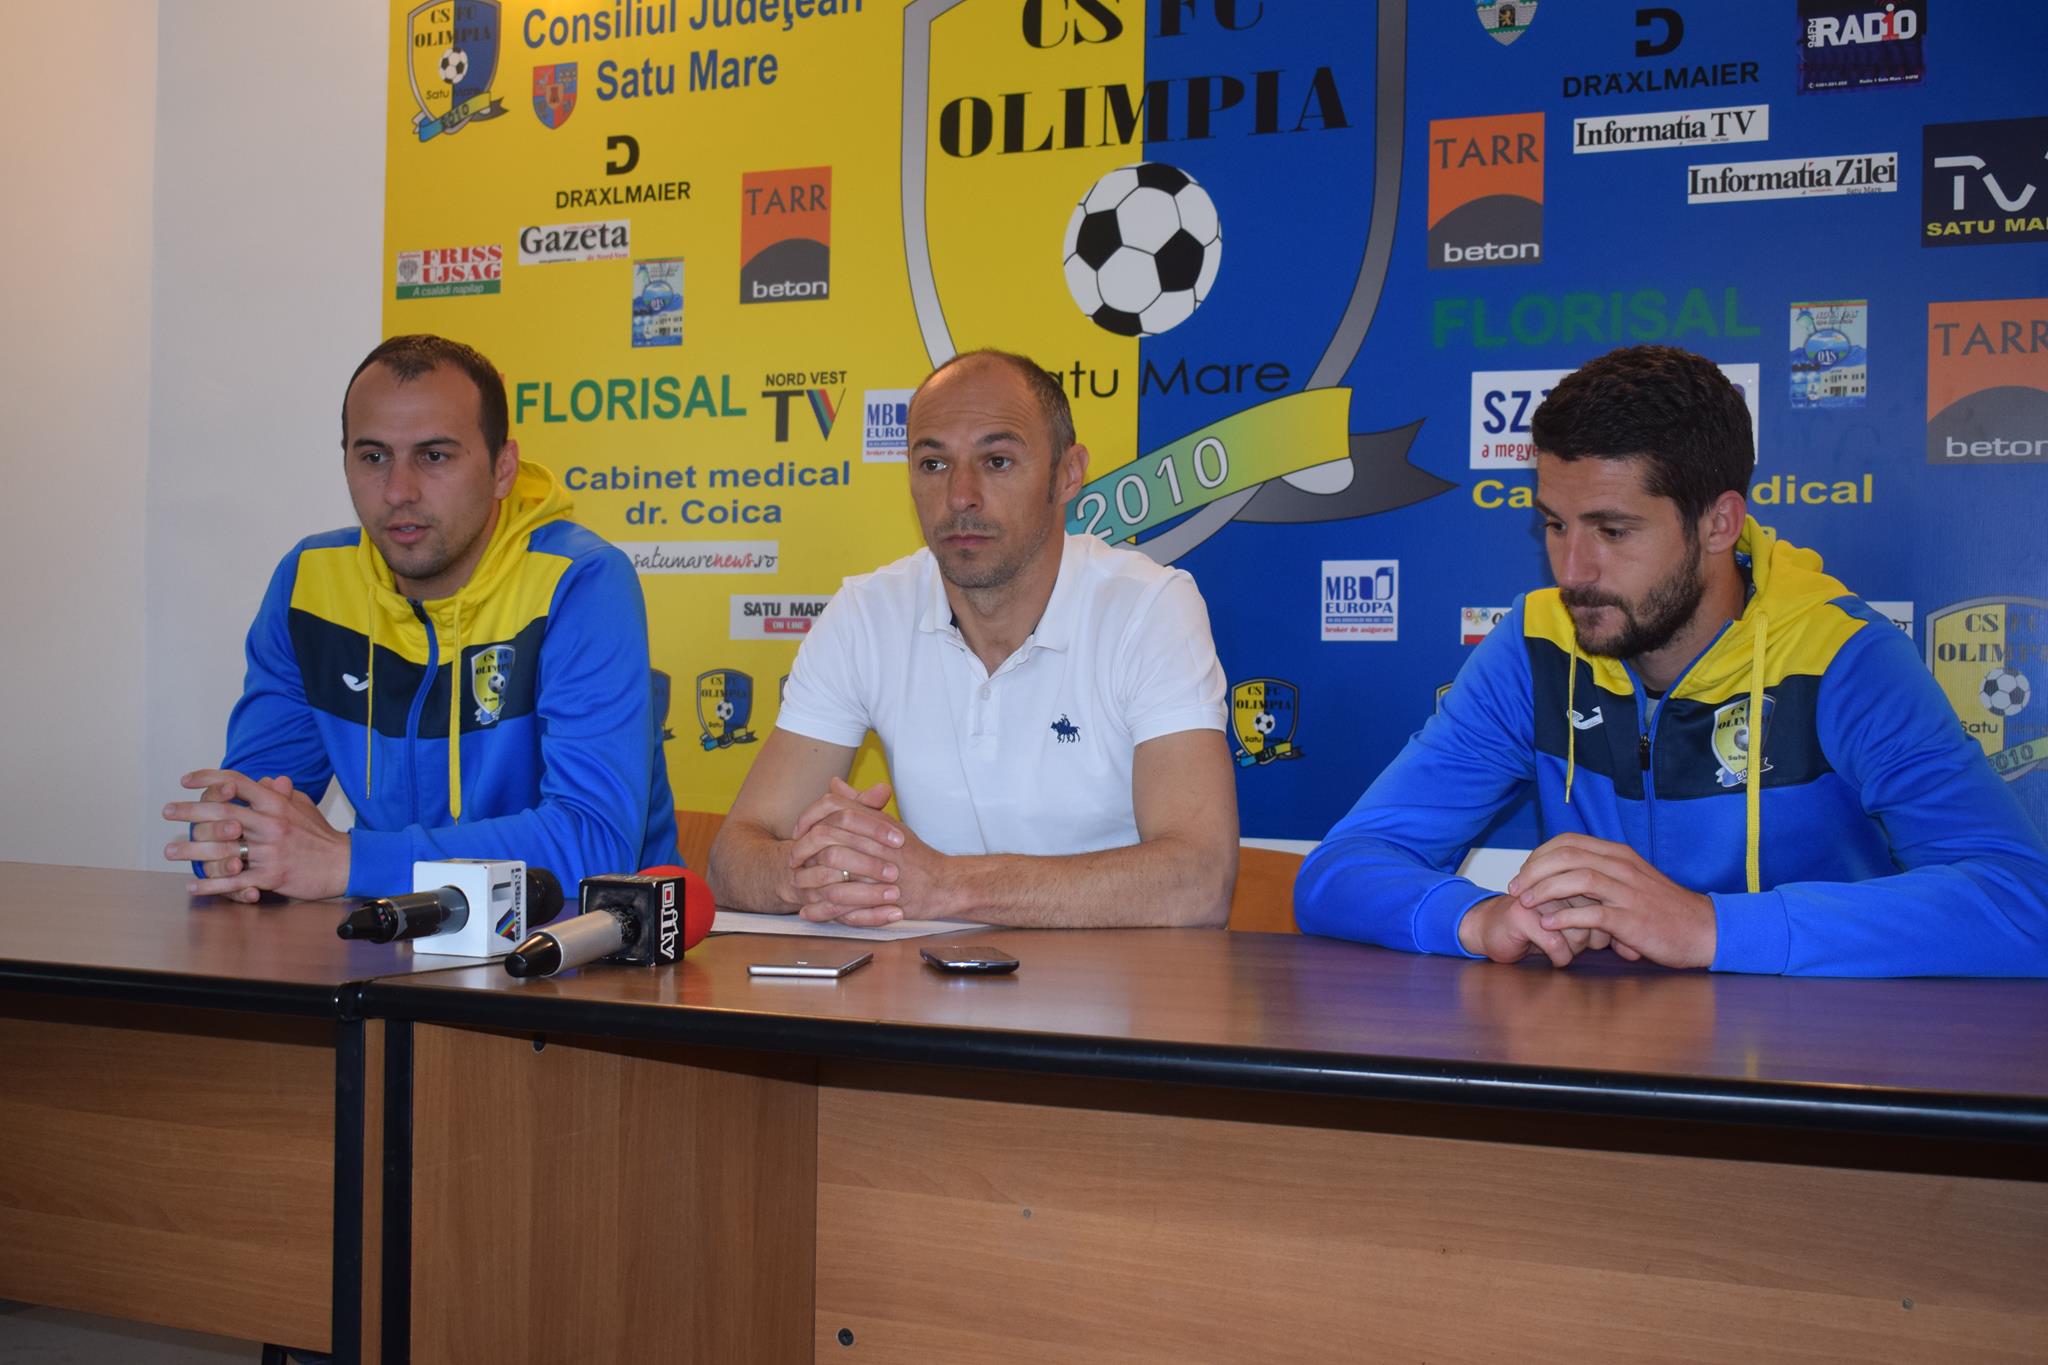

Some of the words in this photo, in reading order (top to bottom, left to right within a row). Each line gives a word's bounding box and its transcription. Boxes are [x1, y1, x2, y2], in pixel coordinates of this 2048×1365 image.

[523, 0, 676, 49] Consiliul
[596, 58, 675, 102] Satu
[690, 49, 778, 93] Mare
[1563, 62, 1759, 98] DRÄXLMAIER
[940, 66, 1353, 158] OLIMPIA
[1711, 111, 1756, 137] TV
[1434, 133, 1539, 170] TARR
[1836, 156, 1896, 186] Zilei
[556, 182, 690, 209] DRÄXLMAIER
[745, 184, 827, 216] TARR
[520, 223, 629, 254] Gazeta
[1927, 220, 1995, 236] SATU
[2005, 217, 2048, 232] MA
[423, 246, 502, 265] FRISS
[1444, 243, 1540, 263] beton
[752, 280, 828, 299] beton
[1433, 287, 1760, 347] FLORISAL
[766, 373, 806, 387] NORD
[810, 371, 847, 384] VEST
[1142, 358, 1290, 395] Mare
[516, 374, 747, 424] FLORISAL
[761, 387, 846, 442] TV
[867, 404, 893, 426] MB
[867, 427, 906, 438] EURO
[1482, 444, 1489, 458] a
[565, 465, 697, 491] Cabinet
[708, 460, 850, 489] medical
[1076, 437, 1229, 540] 2010
[1751, 474, 1873, 504] dical
[625, 500, 668, 525] dr.
[681, 500, 782, 525] Coica
[634, 546, 778, 569] satumarenews.ro
[1326, 576, 1356, 600] MB
[744, 602, 781, 617] SATU
[790, 602, 828, 617] MAR
[1325, 602, 1393, 614] EUROPA
[1965, 613, 1998, 632] CS
[1236, 699, 1291, 710] OLIMPIA
